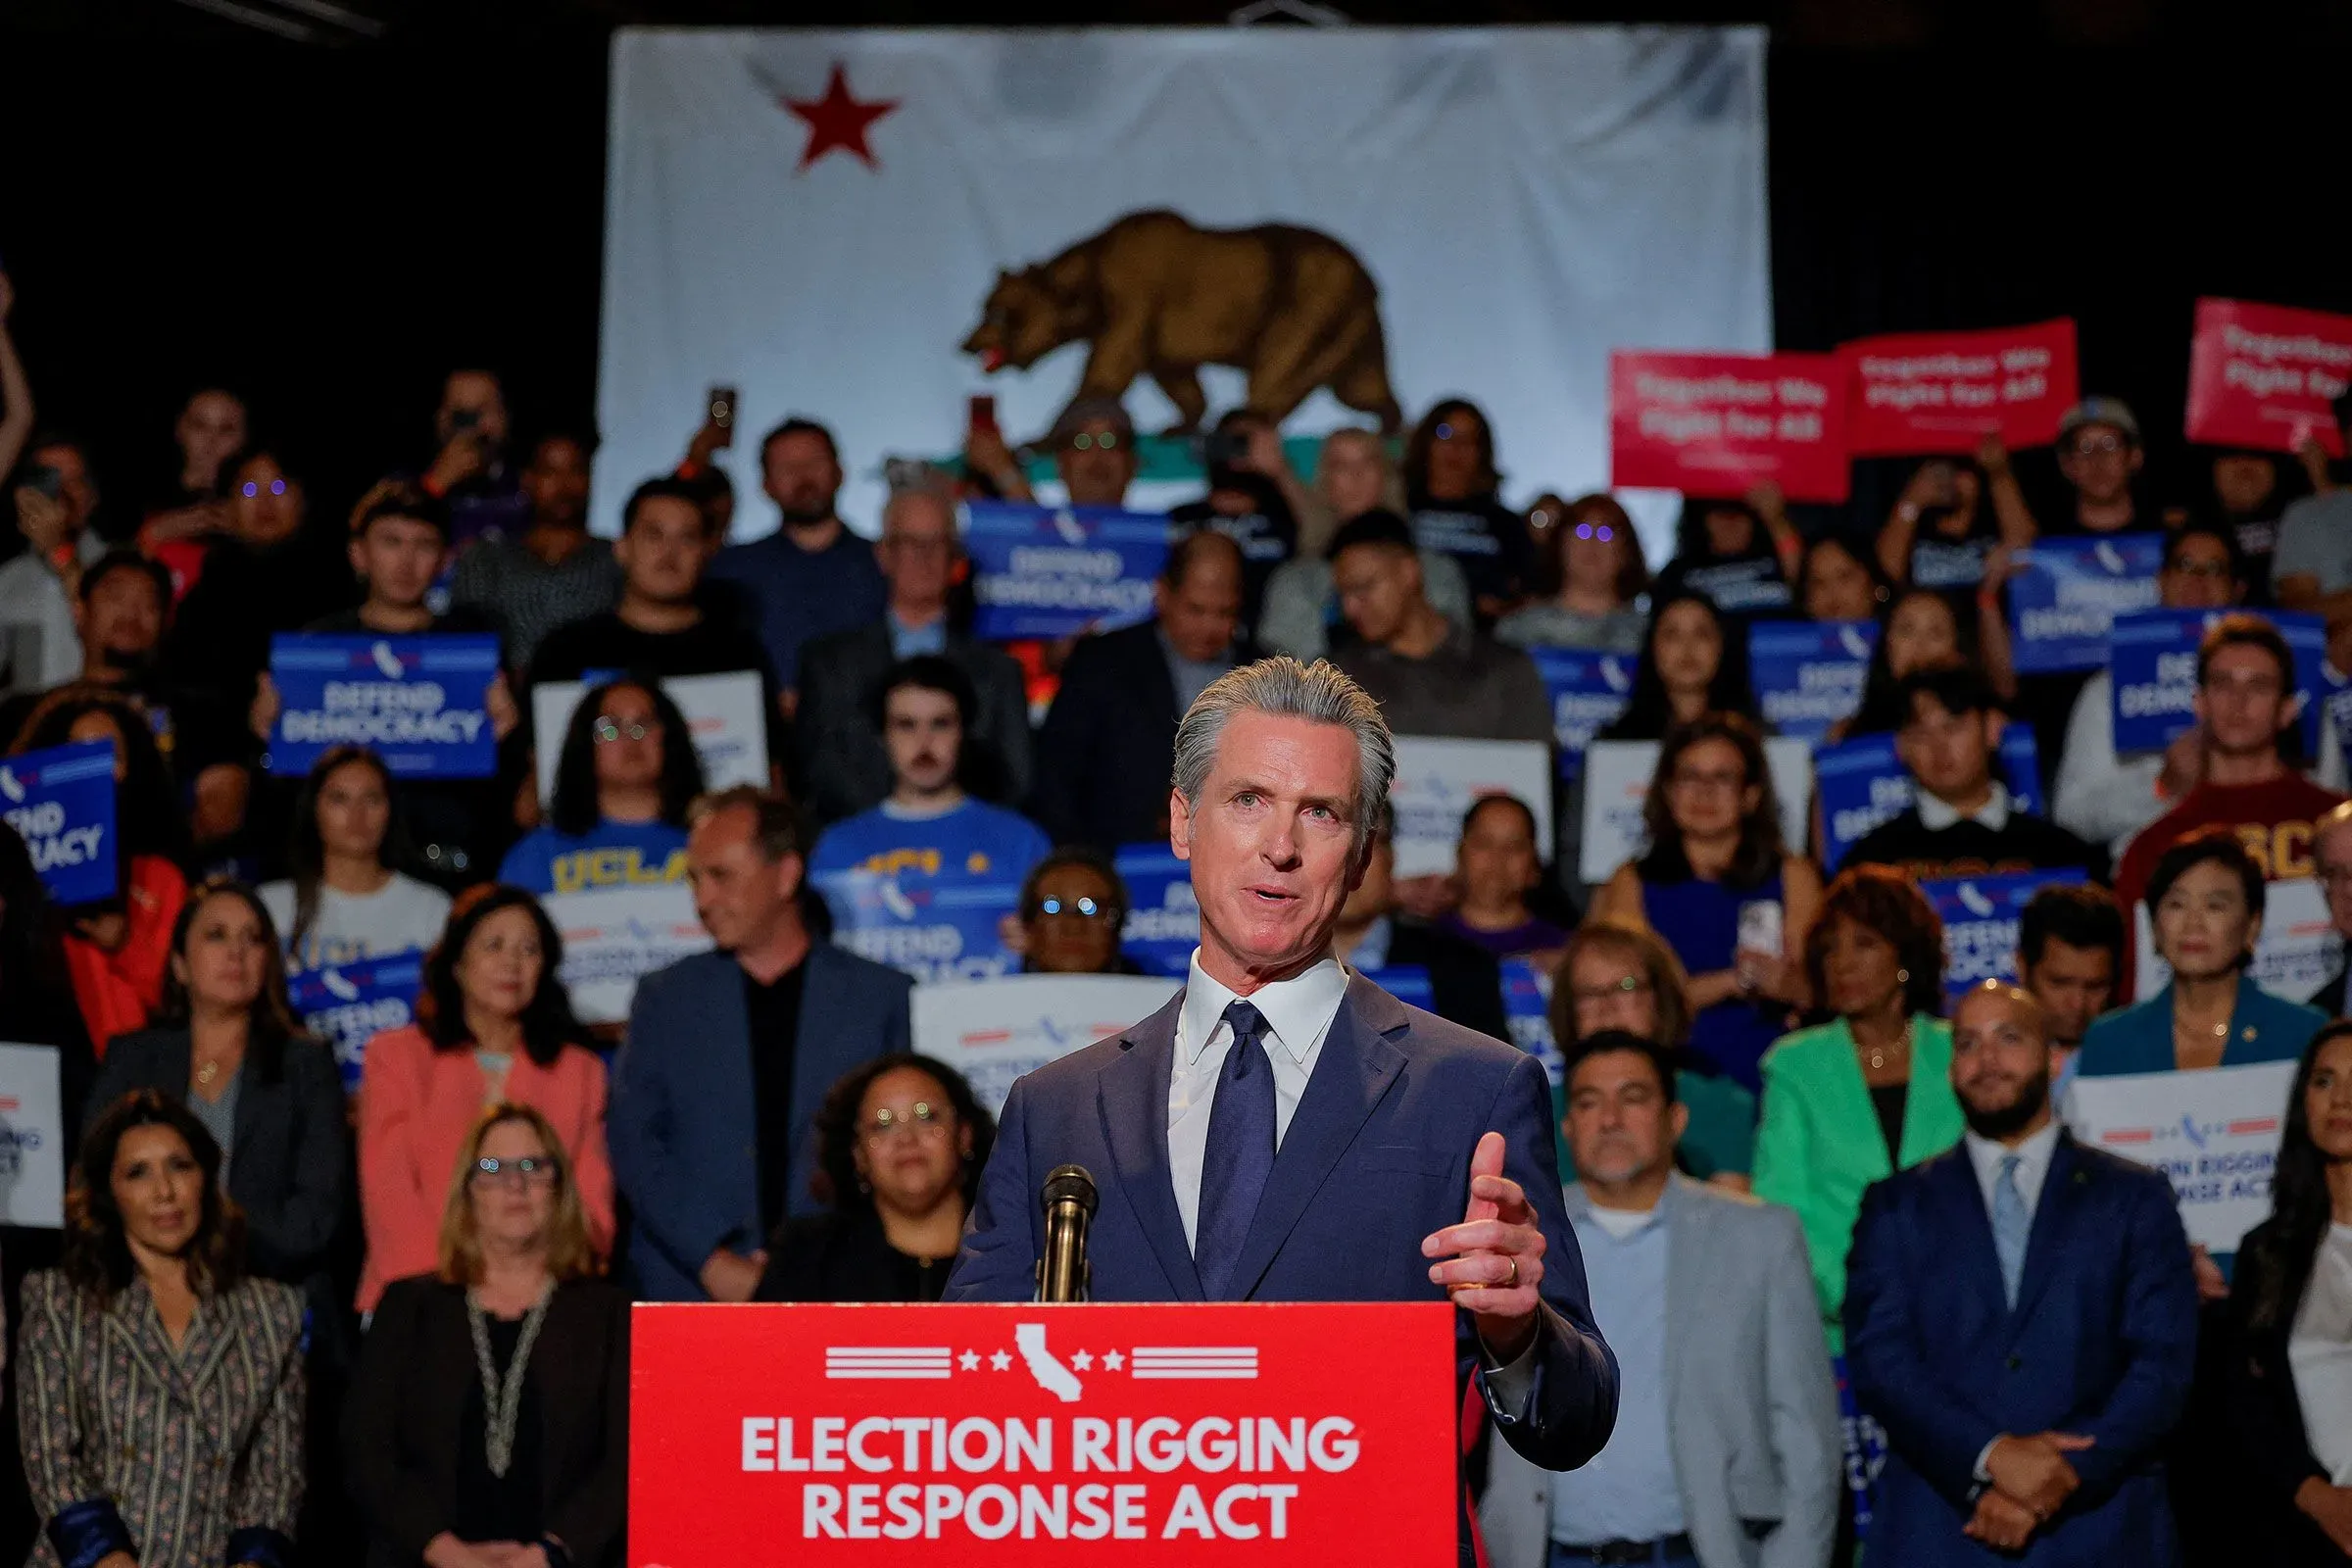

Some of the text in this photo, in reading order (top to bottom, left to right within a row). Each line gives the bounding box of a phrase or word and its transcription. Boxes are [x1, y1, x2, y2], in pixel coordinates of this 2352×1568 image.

[323, 680, 446, 716] DEFEND
[280, 709, 486, 745] DEMOCRACY
[742, 1416, 1360, 1473] ELECTION RIGGING
[803, 1483, 1298, 1540] RESPONSE ACT
